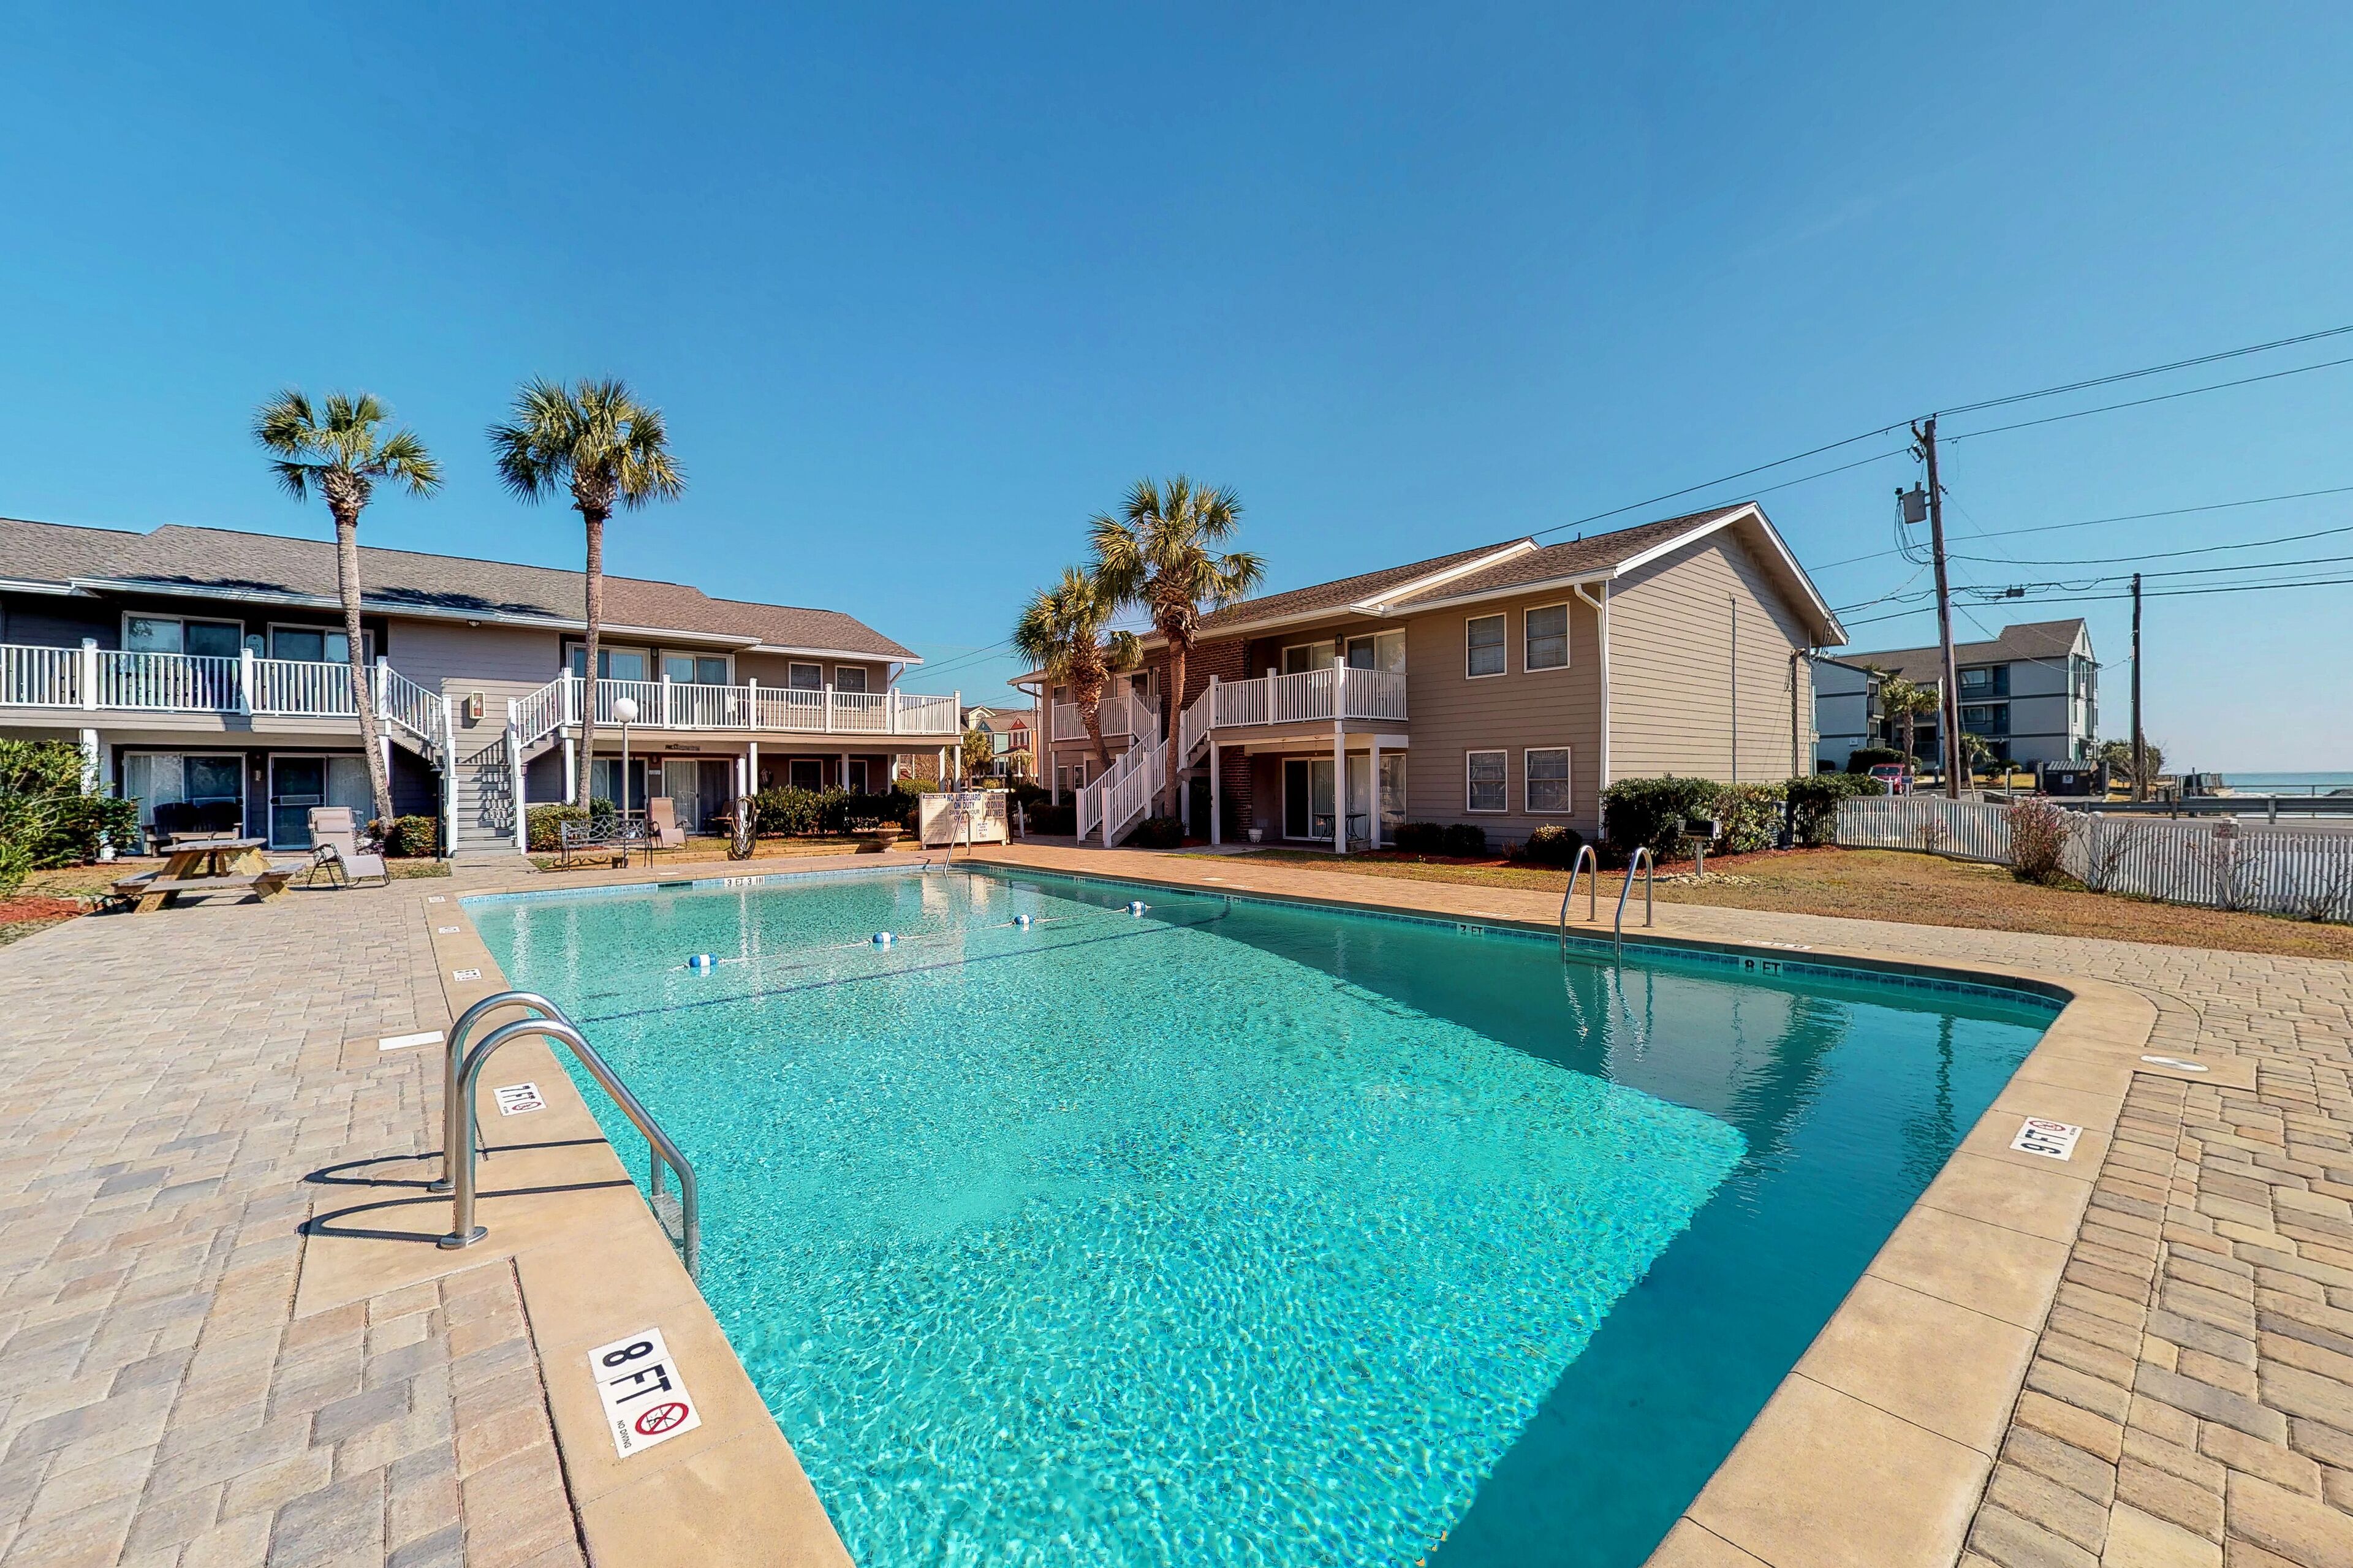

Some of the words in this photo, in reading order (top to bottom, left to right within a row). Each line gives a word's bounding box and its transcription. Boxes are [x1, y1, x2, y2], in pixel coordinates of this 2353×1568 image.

[747, 877, 752, 886] 3
[756, 876, 763, 885] IN
[1471, 926, 1483, 935] FT
[1762, 961, 1781, 974] FT
[502, 1091, 536, 1104] FT
[2025, 1129, 2067, 1146] FT
[2020, 1143, 2061, 1154] 9
[602, 1341, 654, 1367] 8
[610, 1363, 672, 1404] FT
[616, 1420, 626, 1429] NO
[620, 1428, 632, 1449] DIVING
